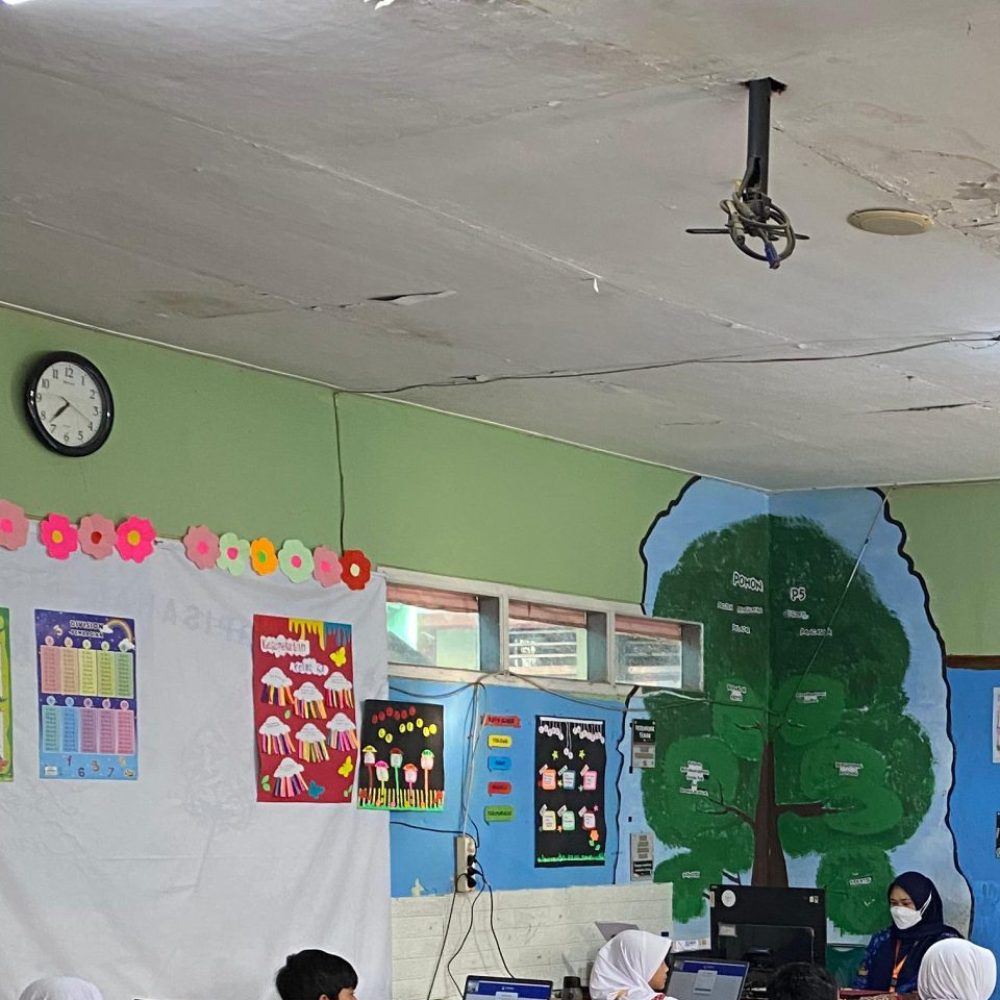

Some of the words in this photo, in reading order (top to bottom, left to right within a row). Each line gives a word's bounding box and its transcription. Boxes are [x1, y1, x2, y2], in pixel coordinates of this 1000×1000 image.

[52, 368, 59, 379] 11
[64, 367, 74, 378] 12
[41, 378, 50, 389] 10
[81, 376, 86, 386] 1
[89, 389, 96, 399] 2
[40, 410, 46, 420] 8
[92, 406, 99, 416] 3
[50, 423, 57, 432] 7
[87, 421, 93, 431] 4
[63, 432, 70, 441] 6
[77, 430, 84, 441] 5
[733, 571, 764, 592] POHON
[790, 587, 806, 601] P5
[77, 767, 86, 777] 6
